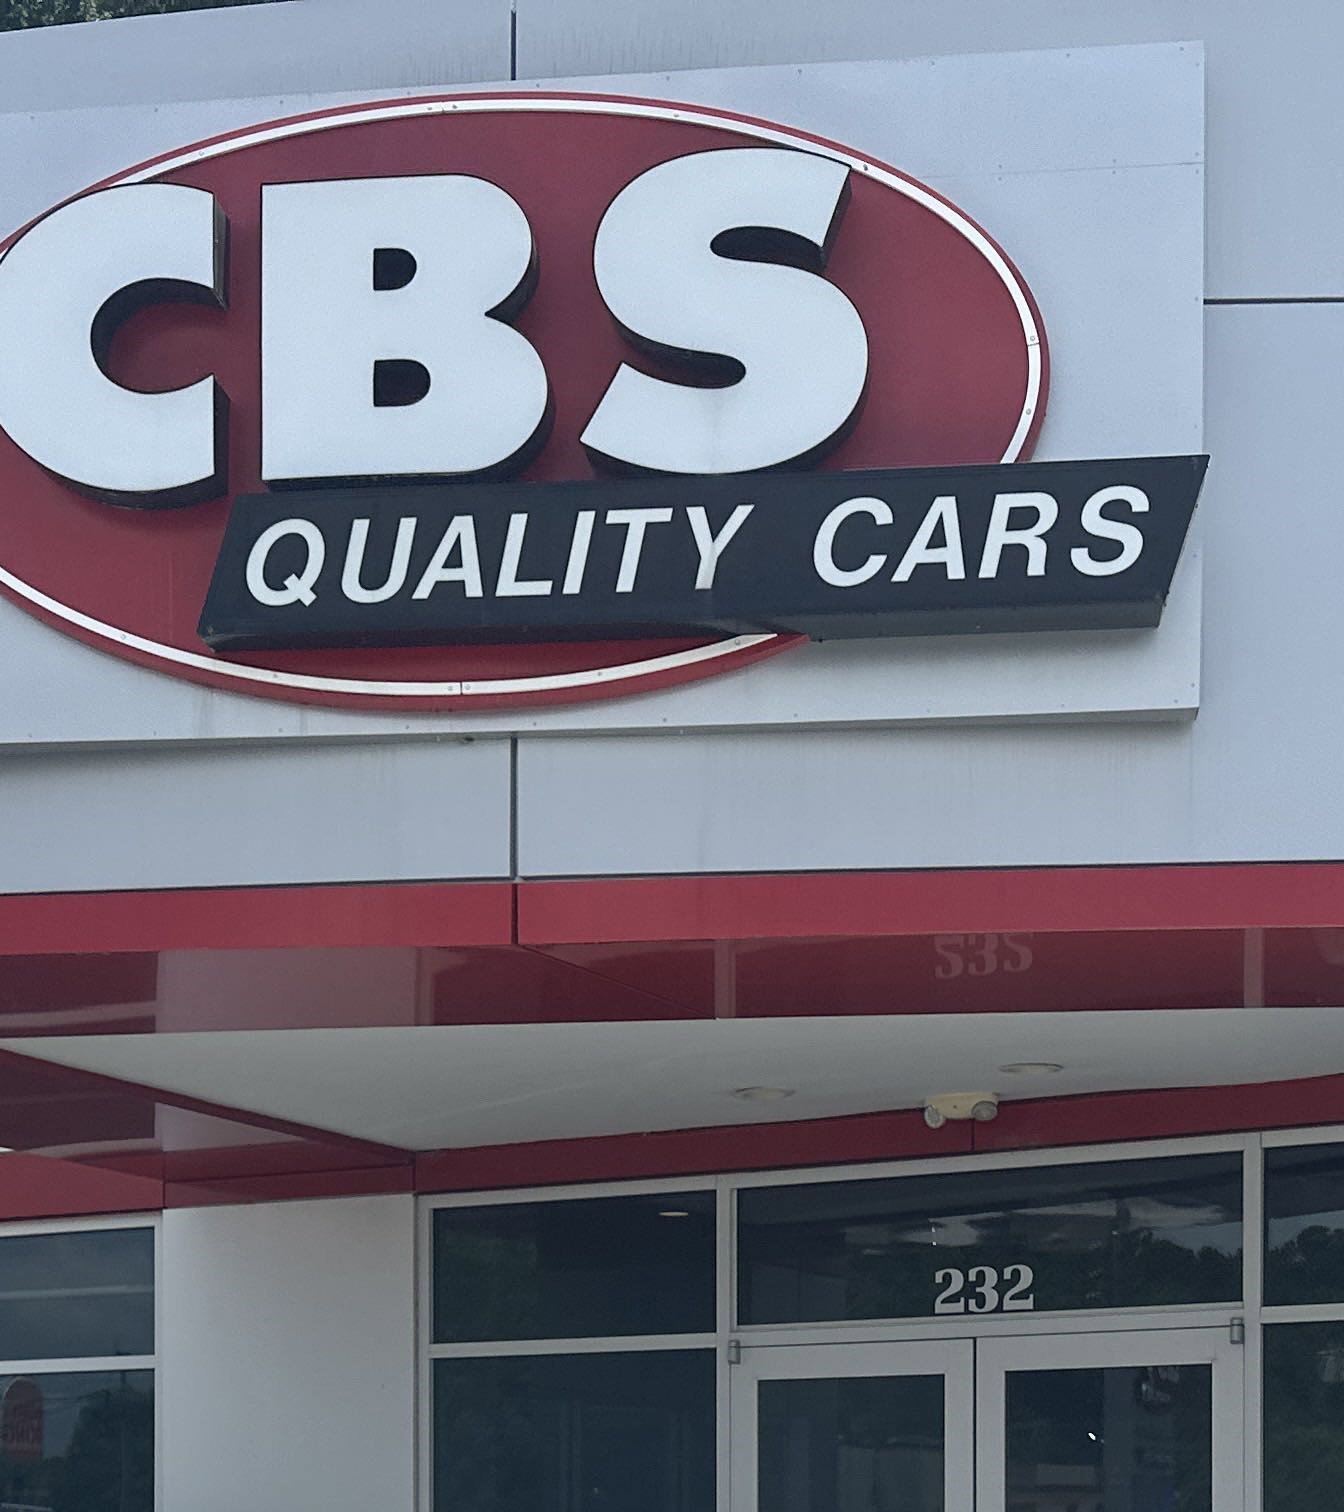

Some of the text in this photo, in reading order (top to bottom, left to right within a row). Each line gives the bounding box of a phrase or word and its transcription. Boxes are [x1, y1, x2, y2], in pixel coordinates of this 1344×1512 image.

[244, 484, 1152, 608] QUALITY CARS
[933, 1264, 1035, 1314] 232
